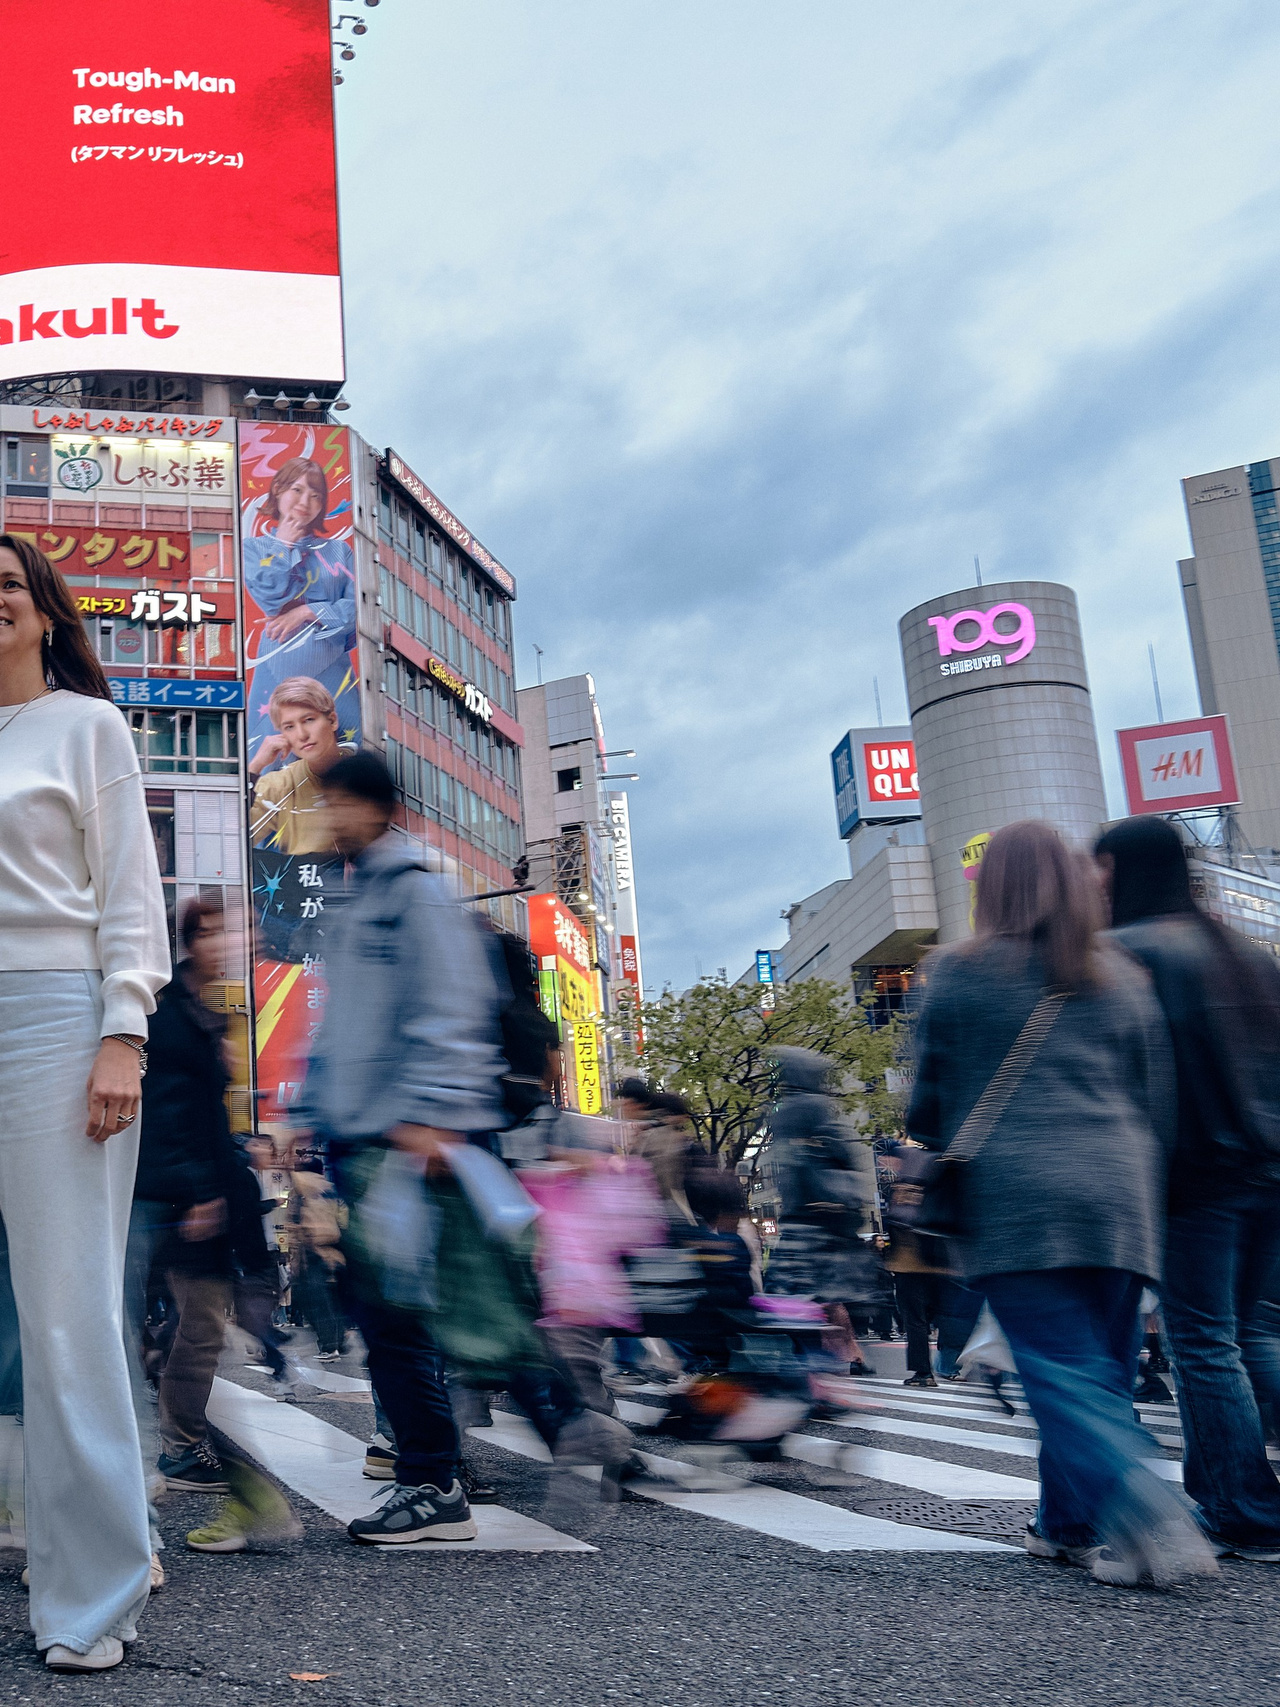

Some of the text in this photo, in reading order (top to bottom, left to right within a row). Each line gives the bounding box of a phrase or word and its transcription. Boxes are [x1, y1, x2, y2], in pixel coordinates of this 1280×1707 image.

[72, 67, 236, 94] Tough-Man
[73, 102, 185, 127] Refresh
[33, 408, 225, 438] しゃぶしゃぶバイキング
[114, 454, 226, 490] しゃぶ葉
[75, 589, 217, 623] ストラン ガスト
[927, 602, 1036, 665] 109
[940, 654, 1002, 676] SHIBUYA
[870, 748, 911, 770] UN
[1151, 747, 1205, 784] H&M
[610, 799, 632, 891] BIC CAMERA
[298, 863, 327, 1043] 私が、始まる
[277, 1081, 303, 1105] 17
[413, 1500, 438, 1521] N
